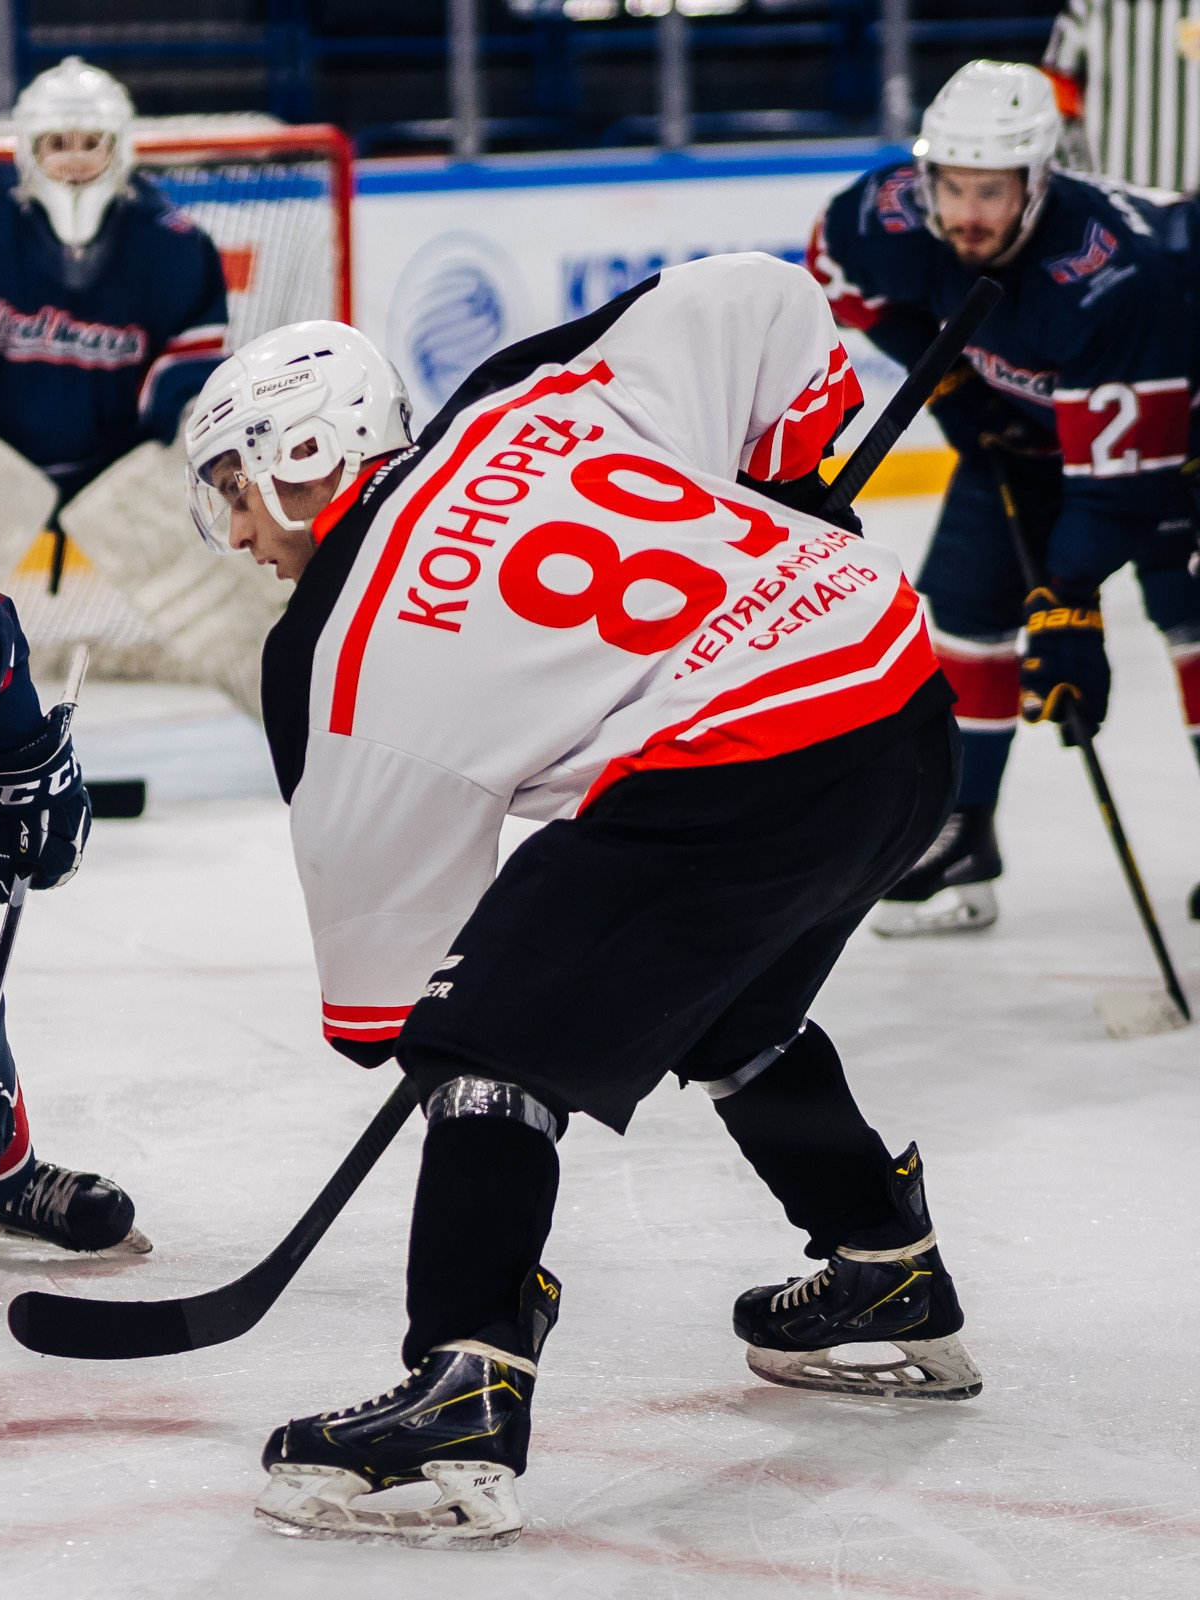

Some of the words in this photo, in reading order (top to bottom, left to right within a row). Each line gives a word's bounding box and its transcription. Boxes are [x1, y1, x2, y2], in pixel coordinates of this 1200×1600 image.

[256, 373, 310, 396] BAUER
[1088, 382, 1140, 476] 2
[498, 453, 790, 656] 89
